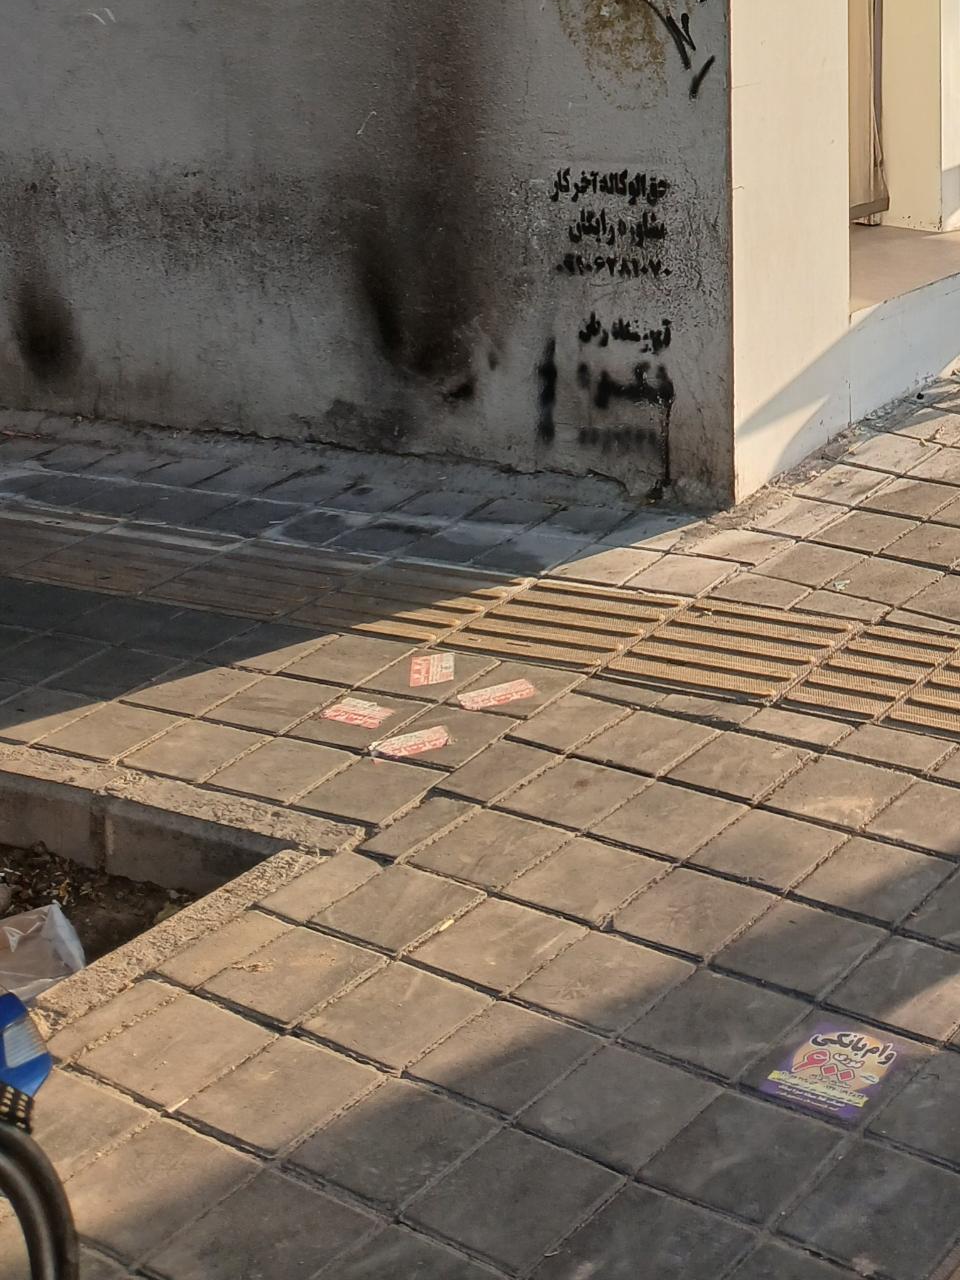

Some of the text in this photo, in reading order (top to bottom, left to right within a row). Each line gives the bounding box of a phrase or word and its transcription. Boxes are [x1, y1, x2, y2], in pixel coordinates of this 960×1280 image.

[549, 168, 571, 202] کار
[571, 170, 599, 202] آخر
[810, 1032, 897, 1067] وام بانکی
